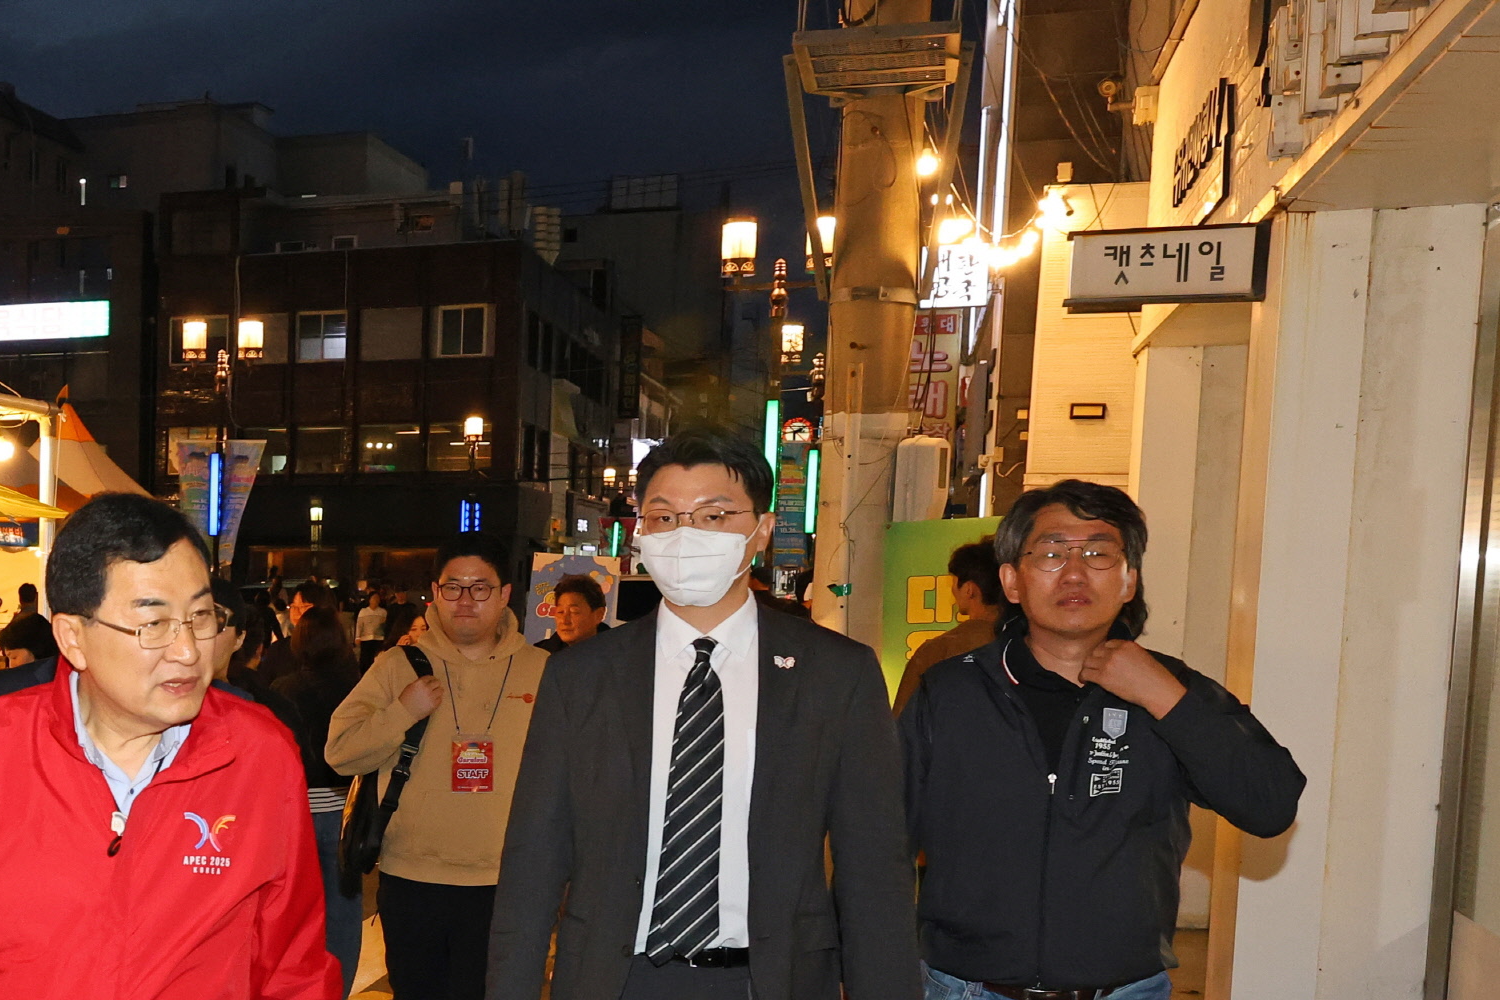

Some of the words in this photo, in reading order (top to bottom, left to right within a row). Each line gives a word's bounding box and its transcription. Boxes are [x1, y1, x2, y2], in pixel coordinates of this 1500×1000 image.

[1103, 241, 1225, 286] 캣츠네일
[457, 769, 489, 779] STAFF
[183, 856, 207, 865] APEC
[210, 856, 231, 867] 2025
